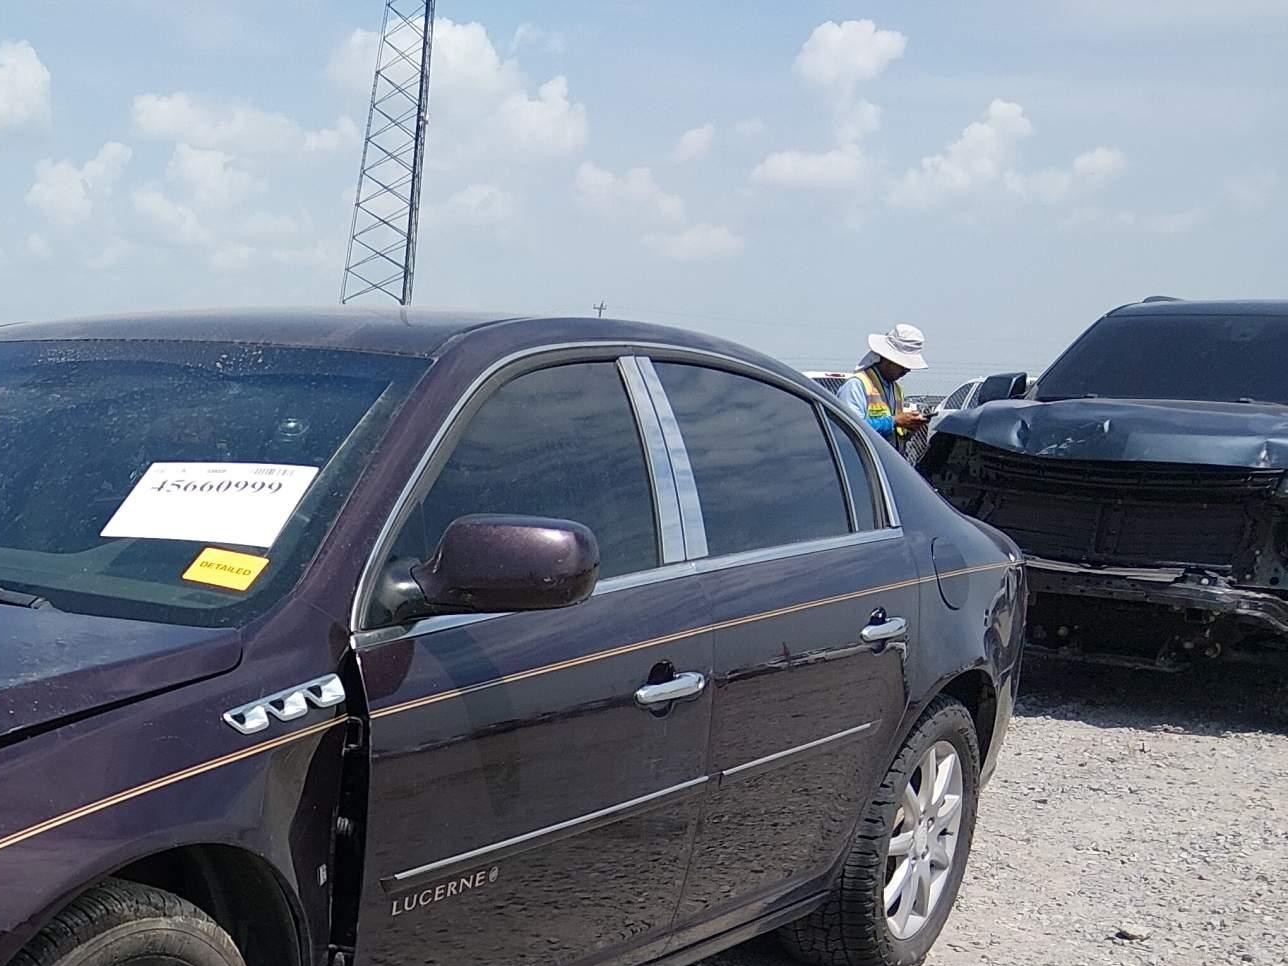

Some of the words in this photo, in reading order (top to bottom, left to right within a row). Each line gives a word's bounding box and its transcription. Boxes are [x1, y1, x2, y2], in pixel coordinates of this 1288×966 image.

[152, 479, 283, 493] 45660999
[199, 560, 252, 576] DETAILED
[391, 871, 486, 916] LUCERNE
